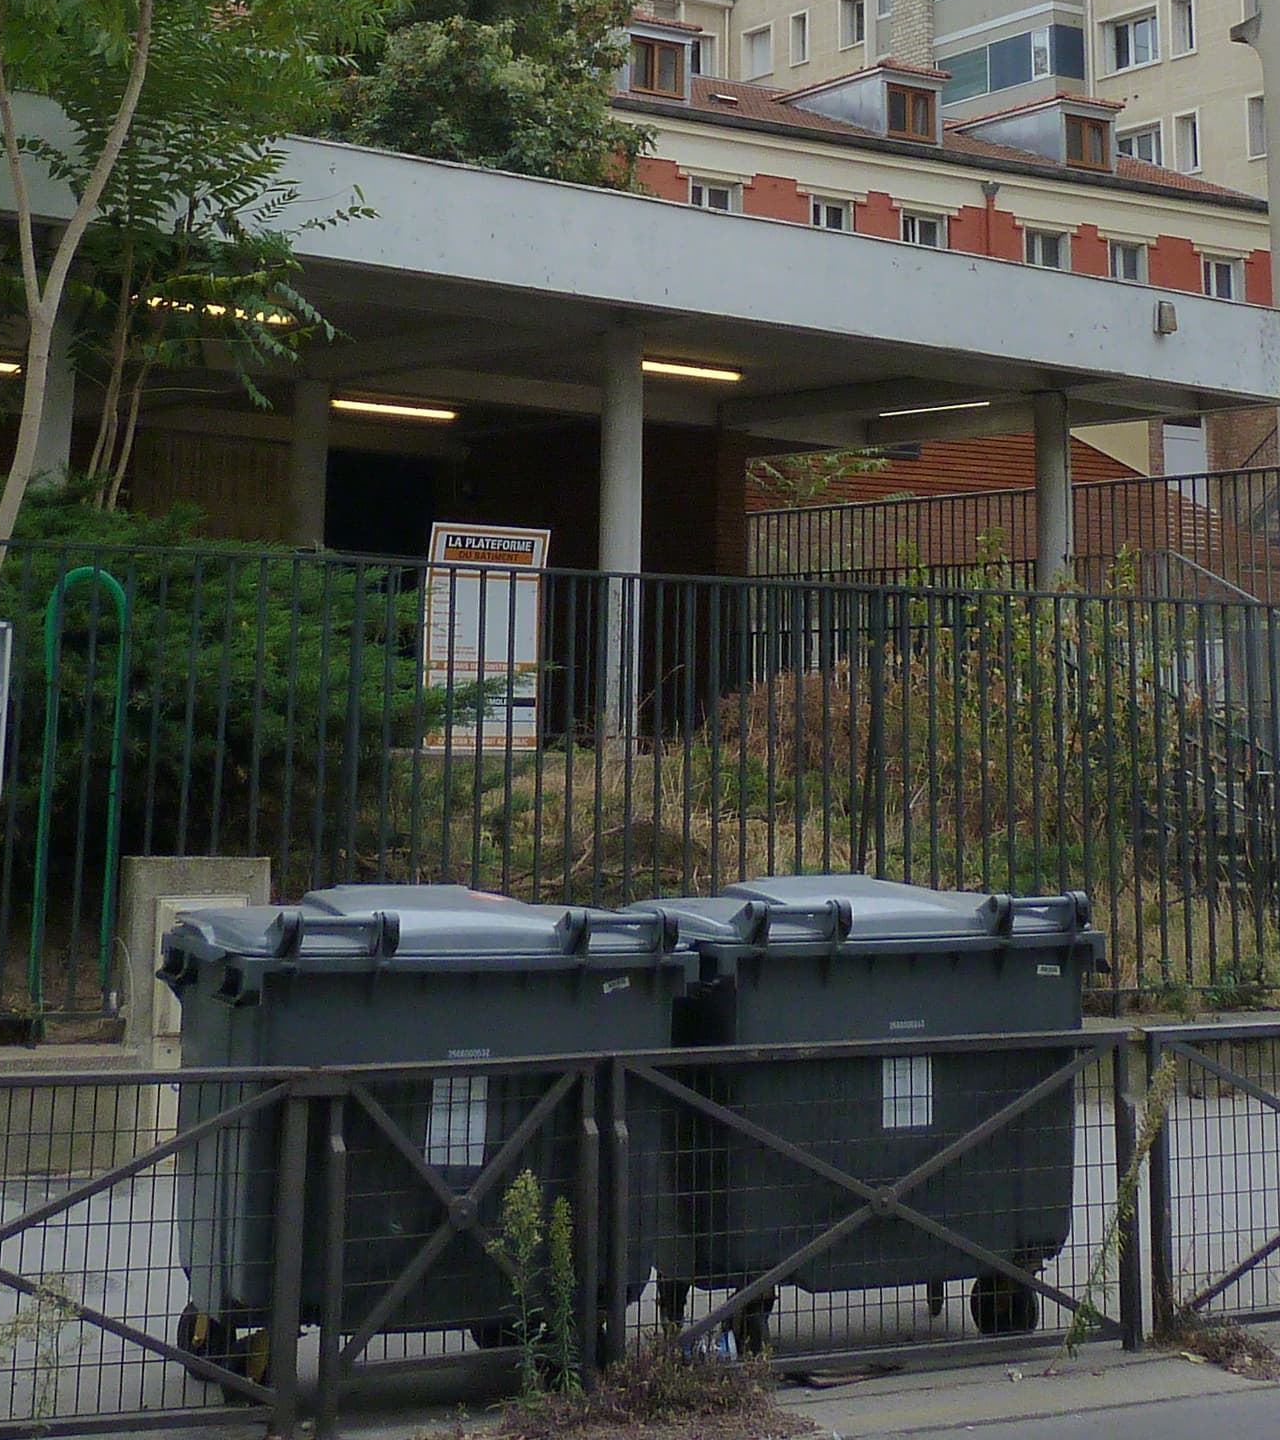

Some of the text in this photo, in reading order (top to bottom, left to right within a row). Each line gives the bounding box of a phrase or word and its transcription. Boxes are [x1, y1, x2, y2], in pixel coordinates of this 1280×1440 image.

[448, 536, 532, 552] LA PLATEFORME
[459, 550, 472, 559] DU
